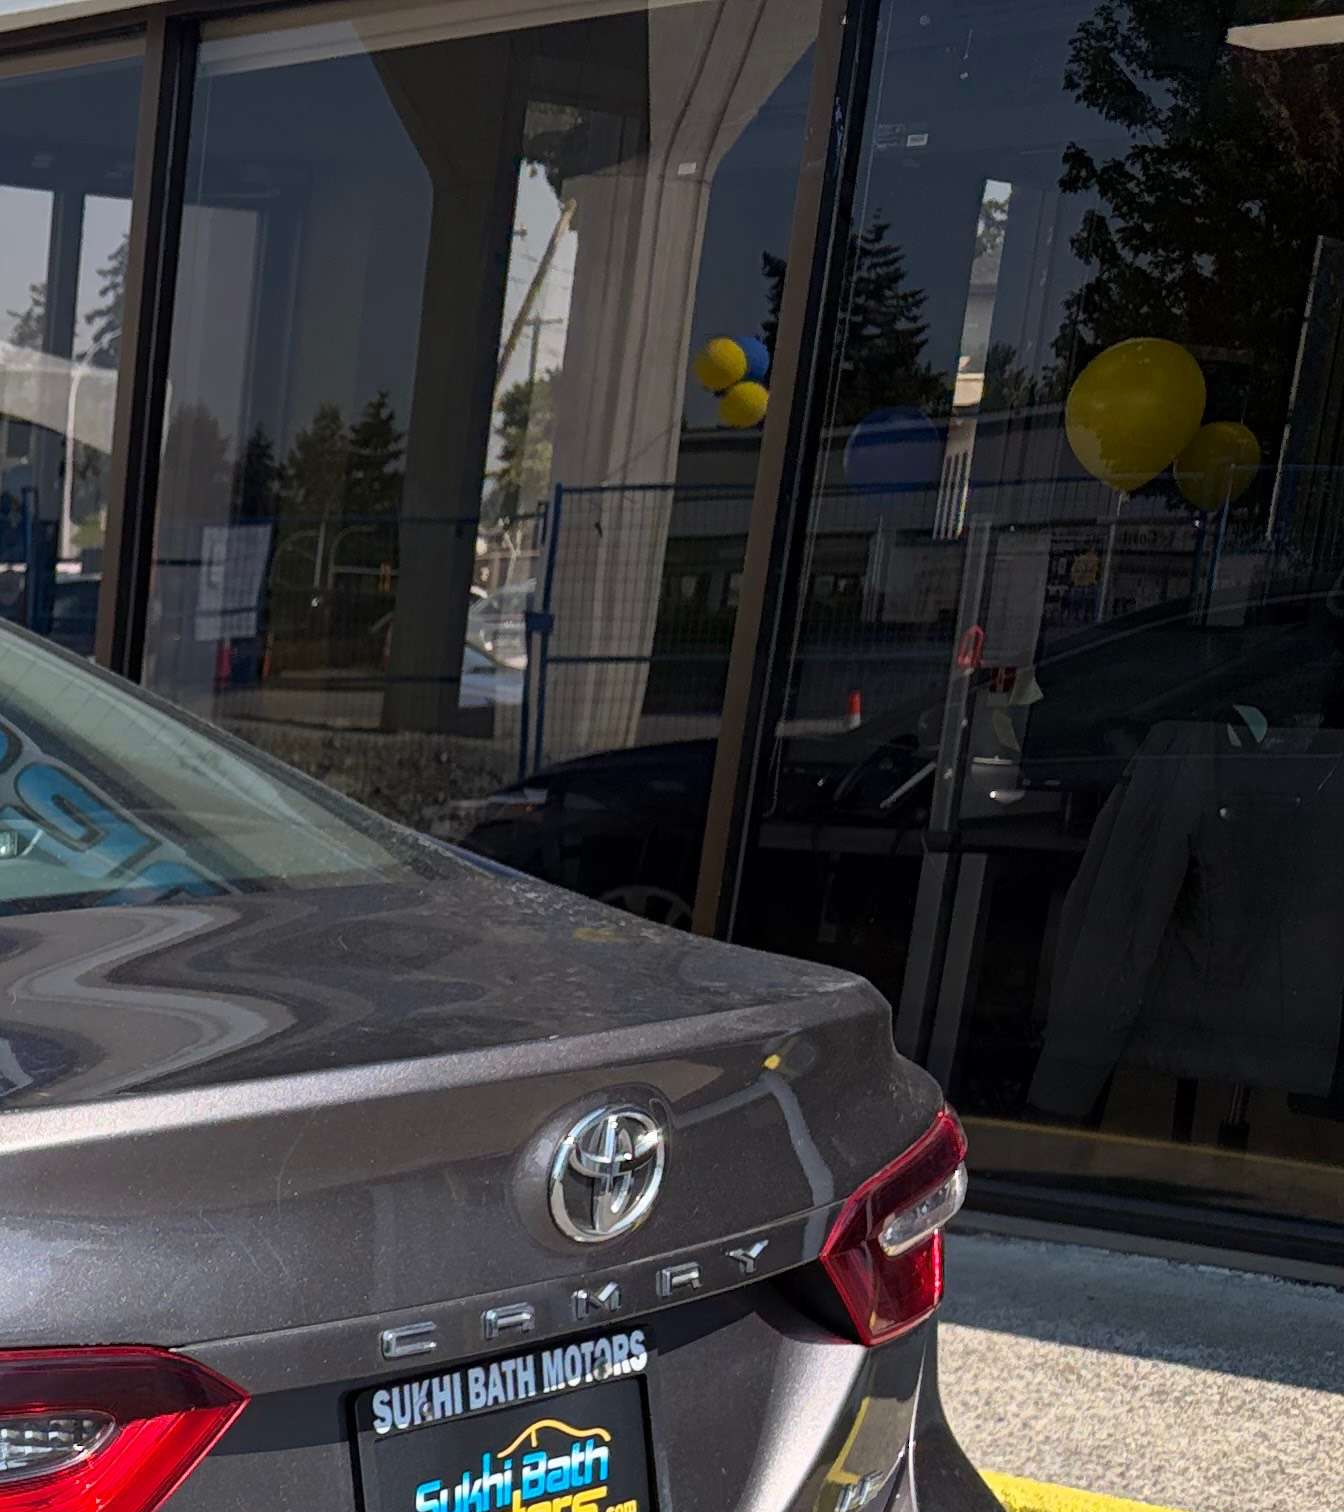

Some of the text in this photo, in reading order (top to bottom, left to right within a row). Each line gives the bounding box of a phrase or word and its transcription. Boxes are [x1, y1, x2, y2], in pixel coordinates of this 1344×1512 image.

[379, 1239, 770, 1361] CAMRY
[372, 1328, 648, 1435] SUKHI BATH MOTORS
[520, 1438, 611, 1501] Bath
